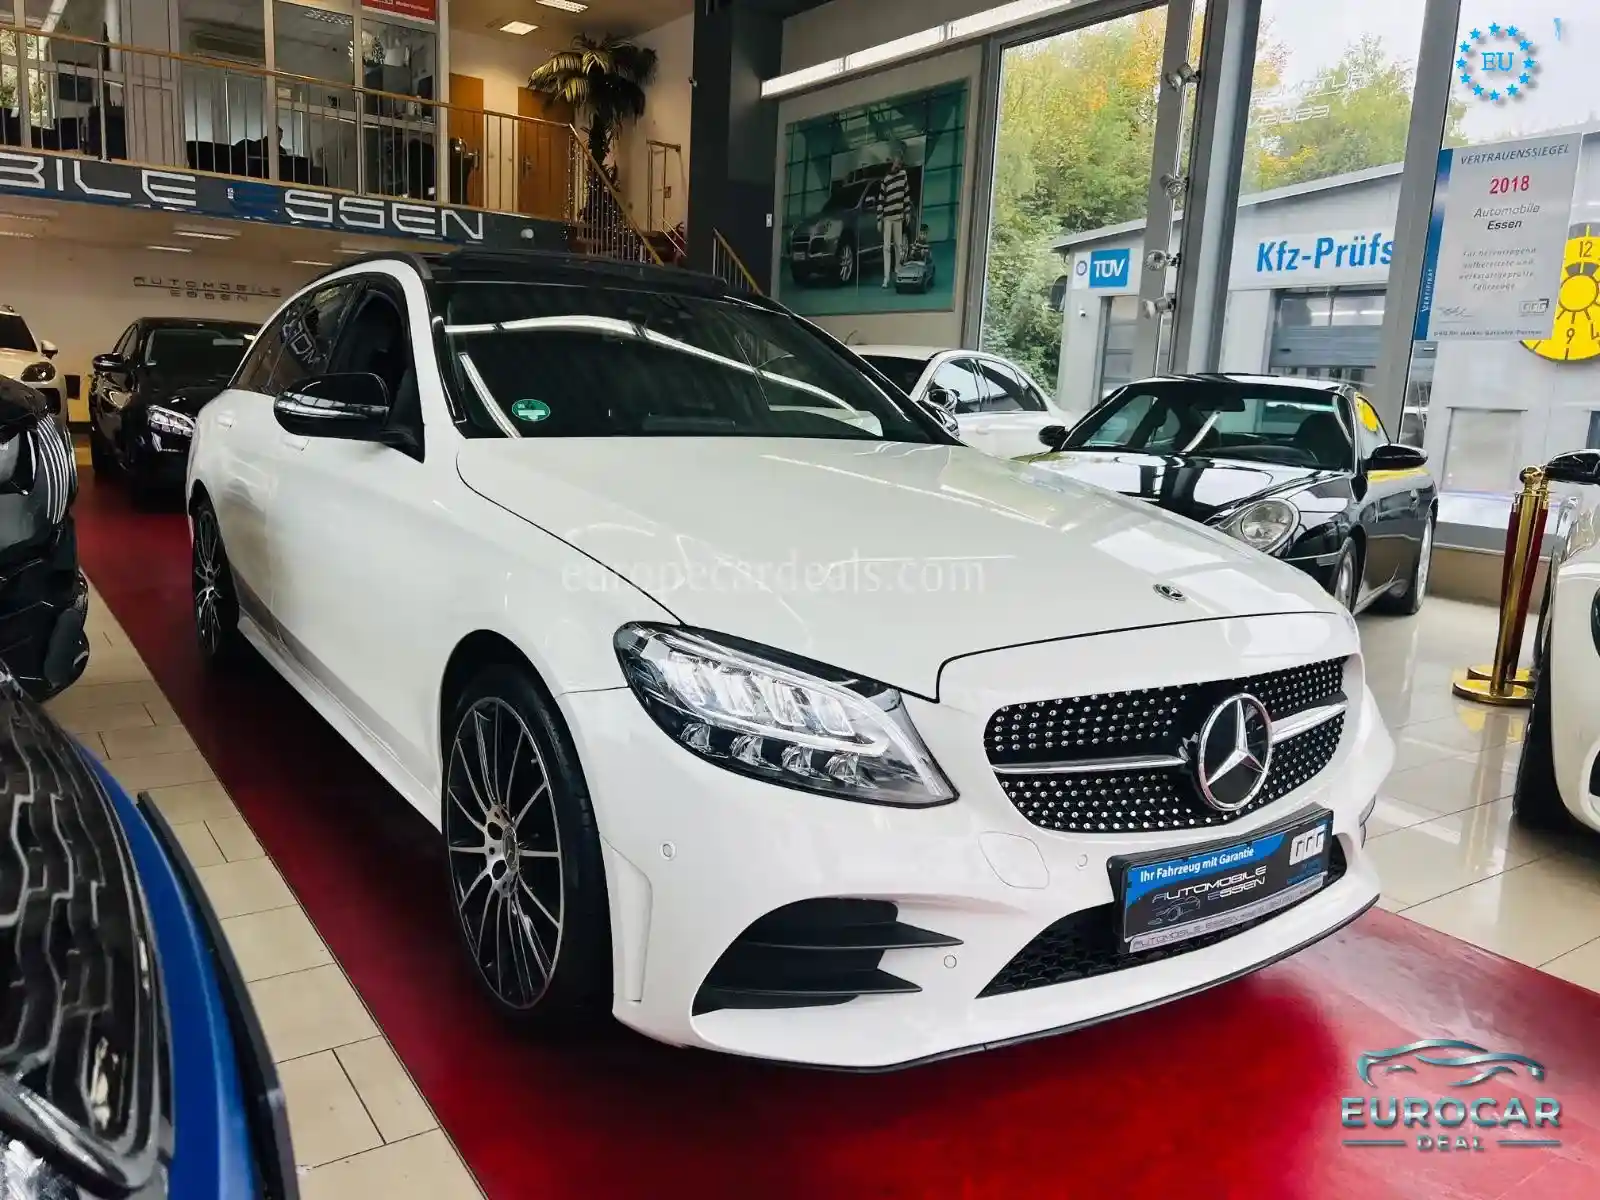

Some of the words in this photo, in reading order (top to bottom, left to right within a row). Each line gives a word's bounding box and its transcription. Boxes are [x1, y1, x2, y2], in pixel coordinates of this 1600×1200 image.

[1460, 143, 1570, 165] VERTRAUENSSIEGEL
[1489, 175, 1530, 194] 2018
[1473, 202, 1541, 218] Automobile
[1487, 219, 1522, 231] Essen
[1579, 240, 1593, 258] 12
[1092, 258, 1126, 278] TÜV
[1140, 869, 1155, 883] Ihr
[1156, 861, 1201, 879] Fahrzeug
[1202, 857, 1218, 870] mit
[1219, 847, 1255, 865] Garantie
[1152, 865, 1268, 904] AUTOMOBILE
[1208, 876, 1267, 901] ESSEN
